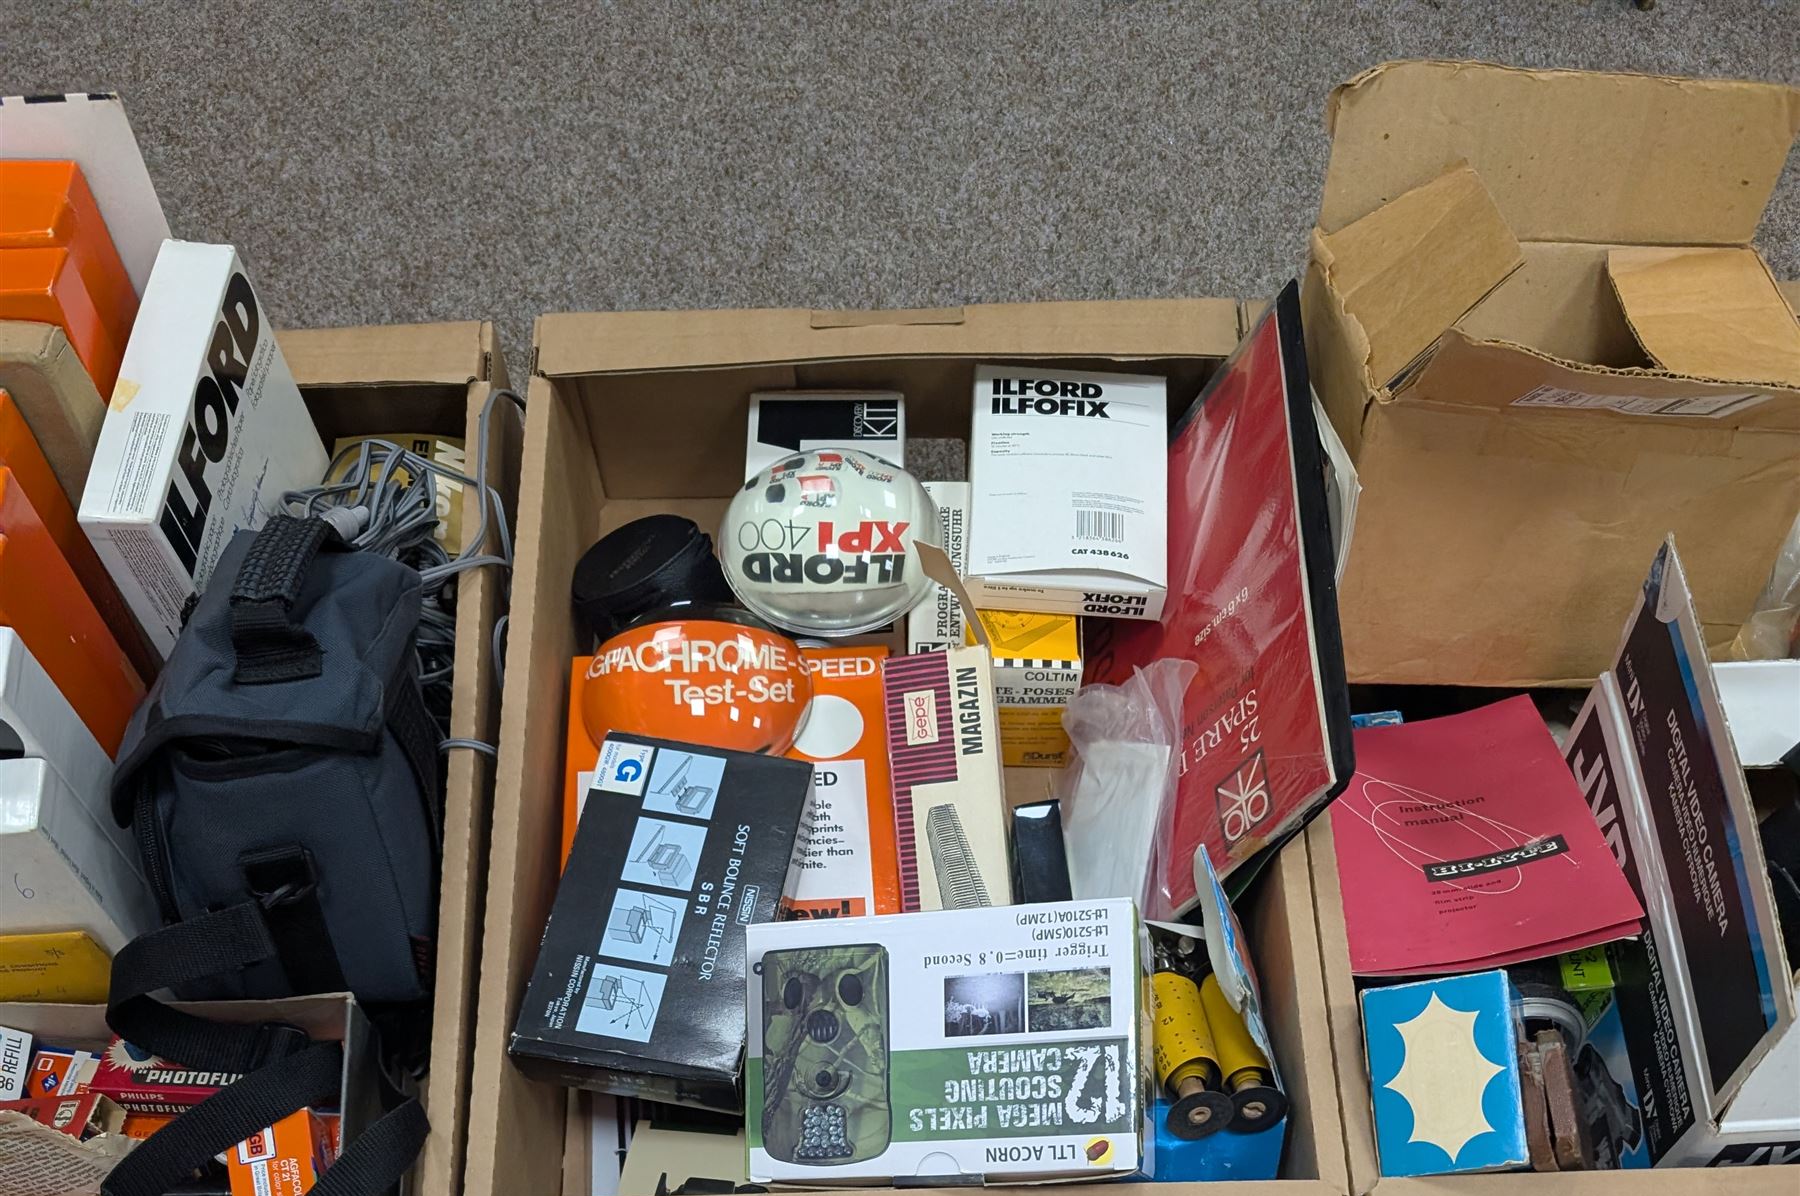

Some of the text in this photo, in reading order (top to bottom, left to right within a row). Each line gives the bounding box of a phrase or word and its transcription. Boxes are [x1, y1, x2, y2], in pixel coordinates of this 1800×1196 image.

[992, 378, 1103, 398] ILFORD
[853, 402, 863, 437] DISCOVERY
[863, 402, 897, 437] KIT
[992, 398, 1111, 418] ILFOFIX
[159, 271, 259, 580] ILFORD
[738, 518, 811, 551] 400
[742, 552, 906, 584] ILFORD
[1083, 593, 1147, 605] ILFOFIX
[1084, 605, 1144, 616] ILFORD
[585, 640, 875, 679] GFACHROME-SPEED
[664, 675, 796, 705] Test-Set
[1023, 687, 1075, 696] POSES
[1024, 672, 1078, 682] COLTIM
[956, 667, 983, 756] MAGAZIN
[1193, 689, 1258, 763] SPARE
[1241, 715, 1262, 754] 25
[615, 759, 642, 782] G
[1398, 795, 1486, 814] Instruction
[1405, 813, 1465, 828] manual
[1666, 708, 1729, 938] DIGITAL VIDEO CAMERA
[1667, 747, 1715, 922] CAMERA VIDEO NUMERIQUE
[826, 846, 854, 857] than
[1668, 784, 1701, 905] KAMERA CYFROWA
[698, 824, 750, 981] SOFT BOUNCE REFLECTOR
[740, 888, 757, 922] NISSIN
[1438, 904, 1478, 915] projector
[923, 953, 971, 969] Second
[1055, 943, 1109, 958] Trigger
[576, 956, 591, 988] Manufactured
[554, 954, 584, 1029] NISSIN CORPORATION
[1161, 1015, 1174, 1026] 12
[1643, 929, 1691, 1122] DIGITAL VIDEO CAMERA
[2, 1037, 22, 1074] REFILL
[967, 1047, 1063, 1075] CAMERA
[1648, 981, 1662, 1029] CAMERA
[1664, 1060, 1684, 1130] NUMERIQUE
[120, 1092, 164, 1101] PHILIPS
[944, 1075, 1063, 1103] SCOUTING
[1058, 1044, 1126, 1125] 12
[1653, 1030, 1679, 1134] KAMERA CYFROWA
[909, 1102, 1063, 1132] MEGA PIXELS
[249, 1134, 264, 1156] GB
[985, 1144, 1076, 1163] LTL ACORN
[273, 1171, 282, 1191] color
[280, 1159, 291, 1182] CT 21
